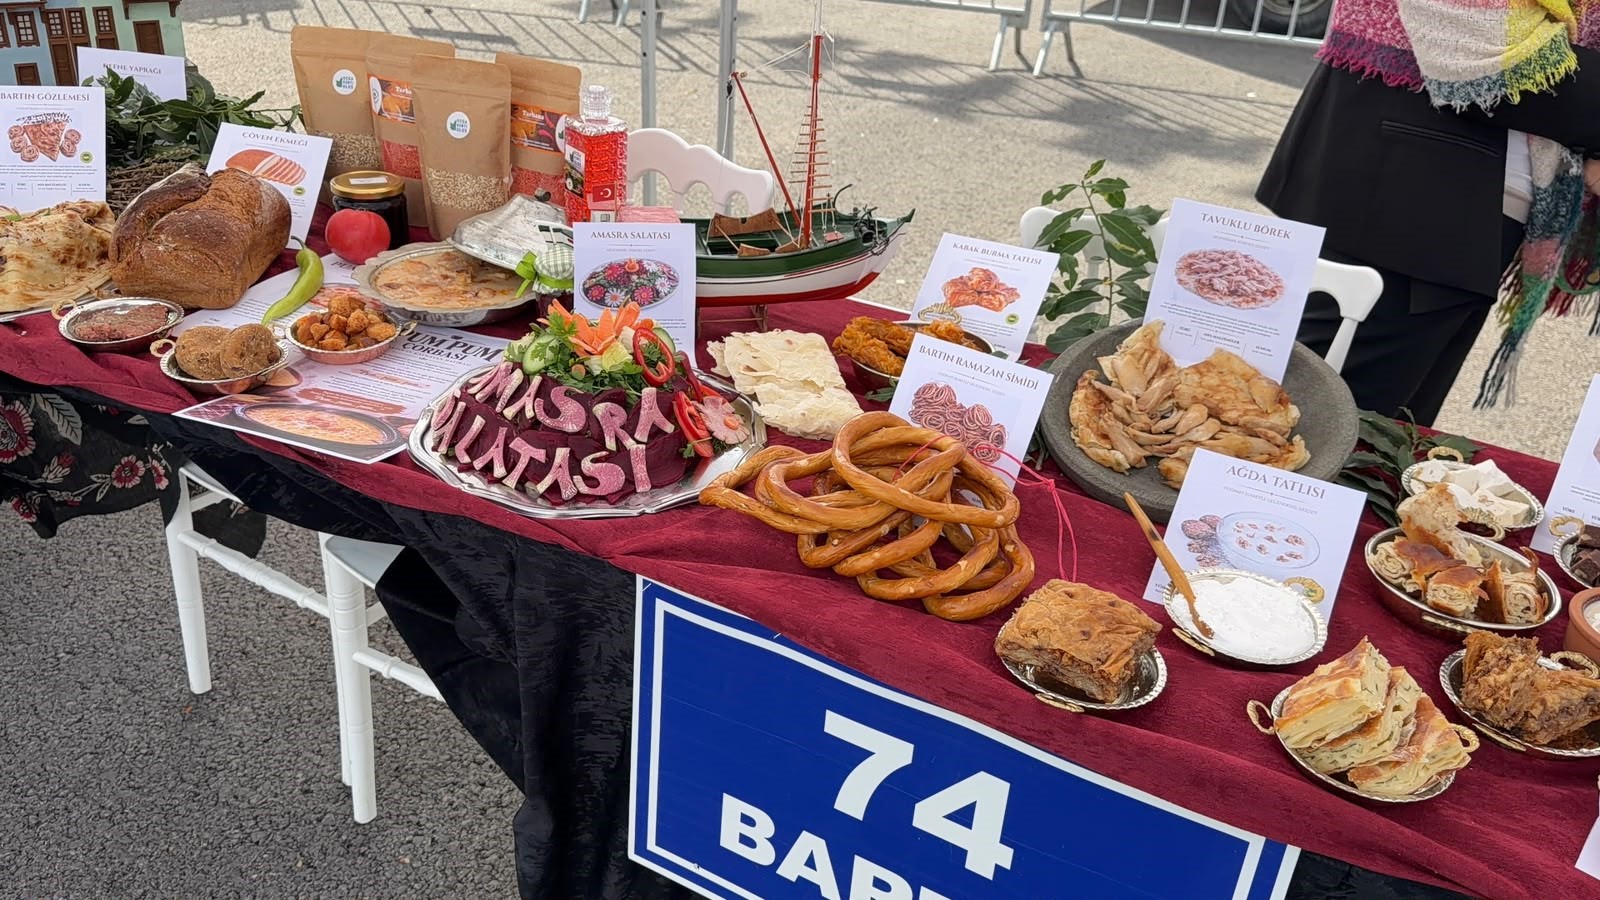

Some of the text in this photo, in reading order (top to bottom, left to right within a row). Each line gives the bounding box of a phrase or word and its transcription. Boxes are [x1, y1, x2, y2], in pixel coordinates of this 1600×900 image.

[37, 92, 90, 101] GÖZLEMESİ
[395, 86, 412, 95] Tarha
[522, 110, 544, 120] Tarhana
[591, 231, 671, 240] AMASRA SALATASI
[1201, 213, 1292, 239] TAVUKLU BÖREK
[952, 242, 979, 253] KABAK
[981, 248, 1010, 260] BURMA
[1012, 254, 1042, 265] TATLISI
[444, 340, 504, 362] PUM
[919, 345, 1039, 390] BARTIN RAMAZAN SİMİDİ
[1226, 465, 1326, 499] AĞDA TATLISI
[823, 709, 1015, 881] 74
